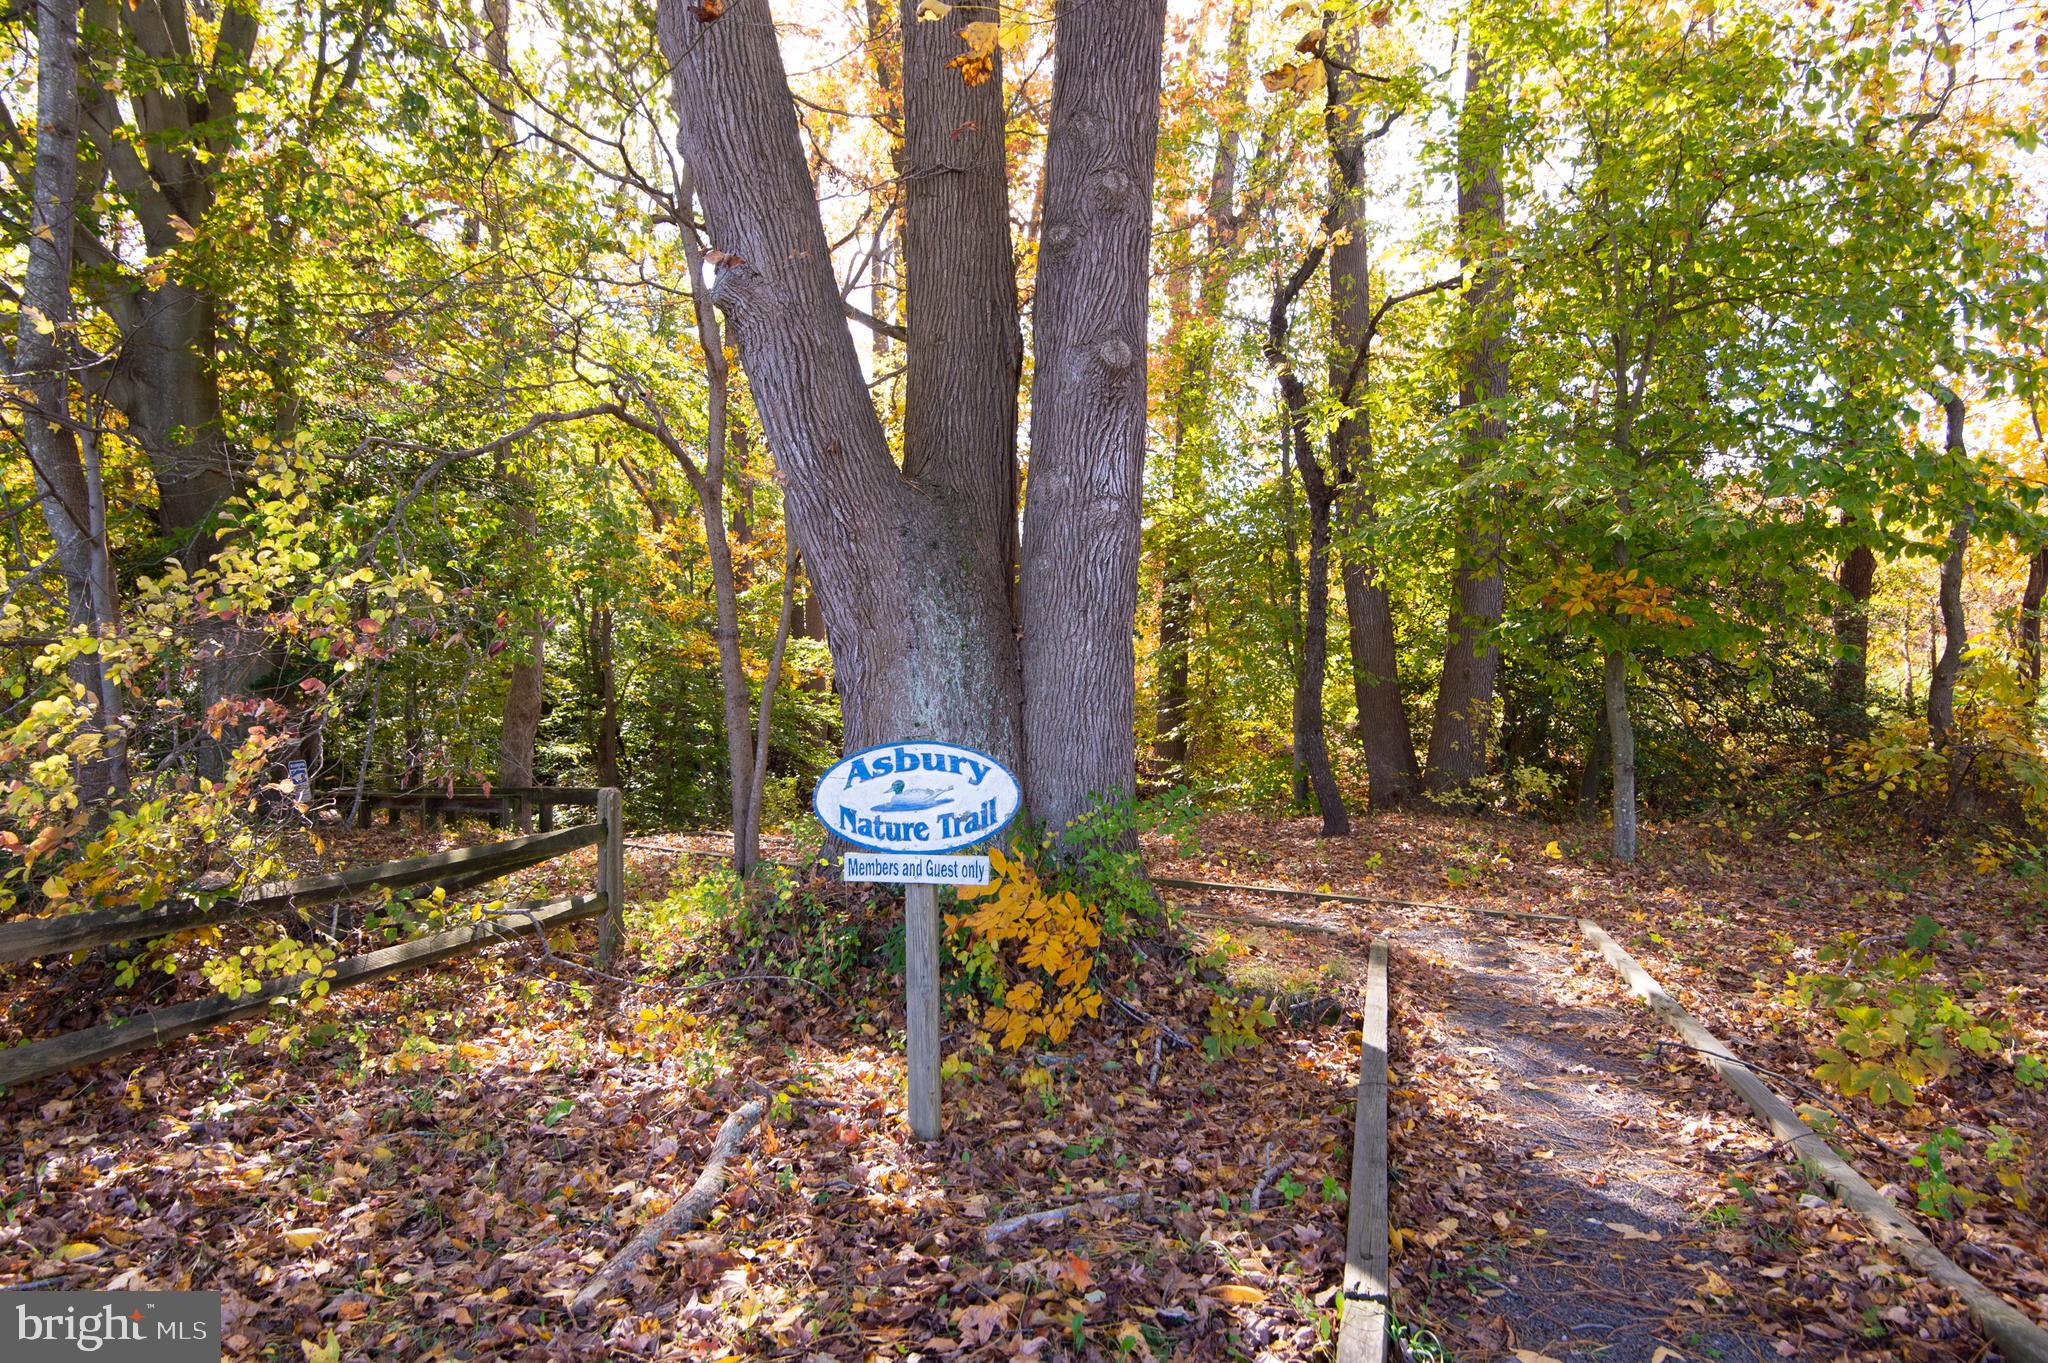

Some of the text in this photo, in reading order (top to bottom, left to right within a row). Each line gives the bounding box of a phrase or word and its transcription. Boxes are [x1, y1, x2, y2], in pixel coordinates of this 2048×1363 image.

[844, 747, 992, 790] Asbury
[839, 796, 999, 842] Nature Trail
[848, 858, 985, 882] Members and Guest only
